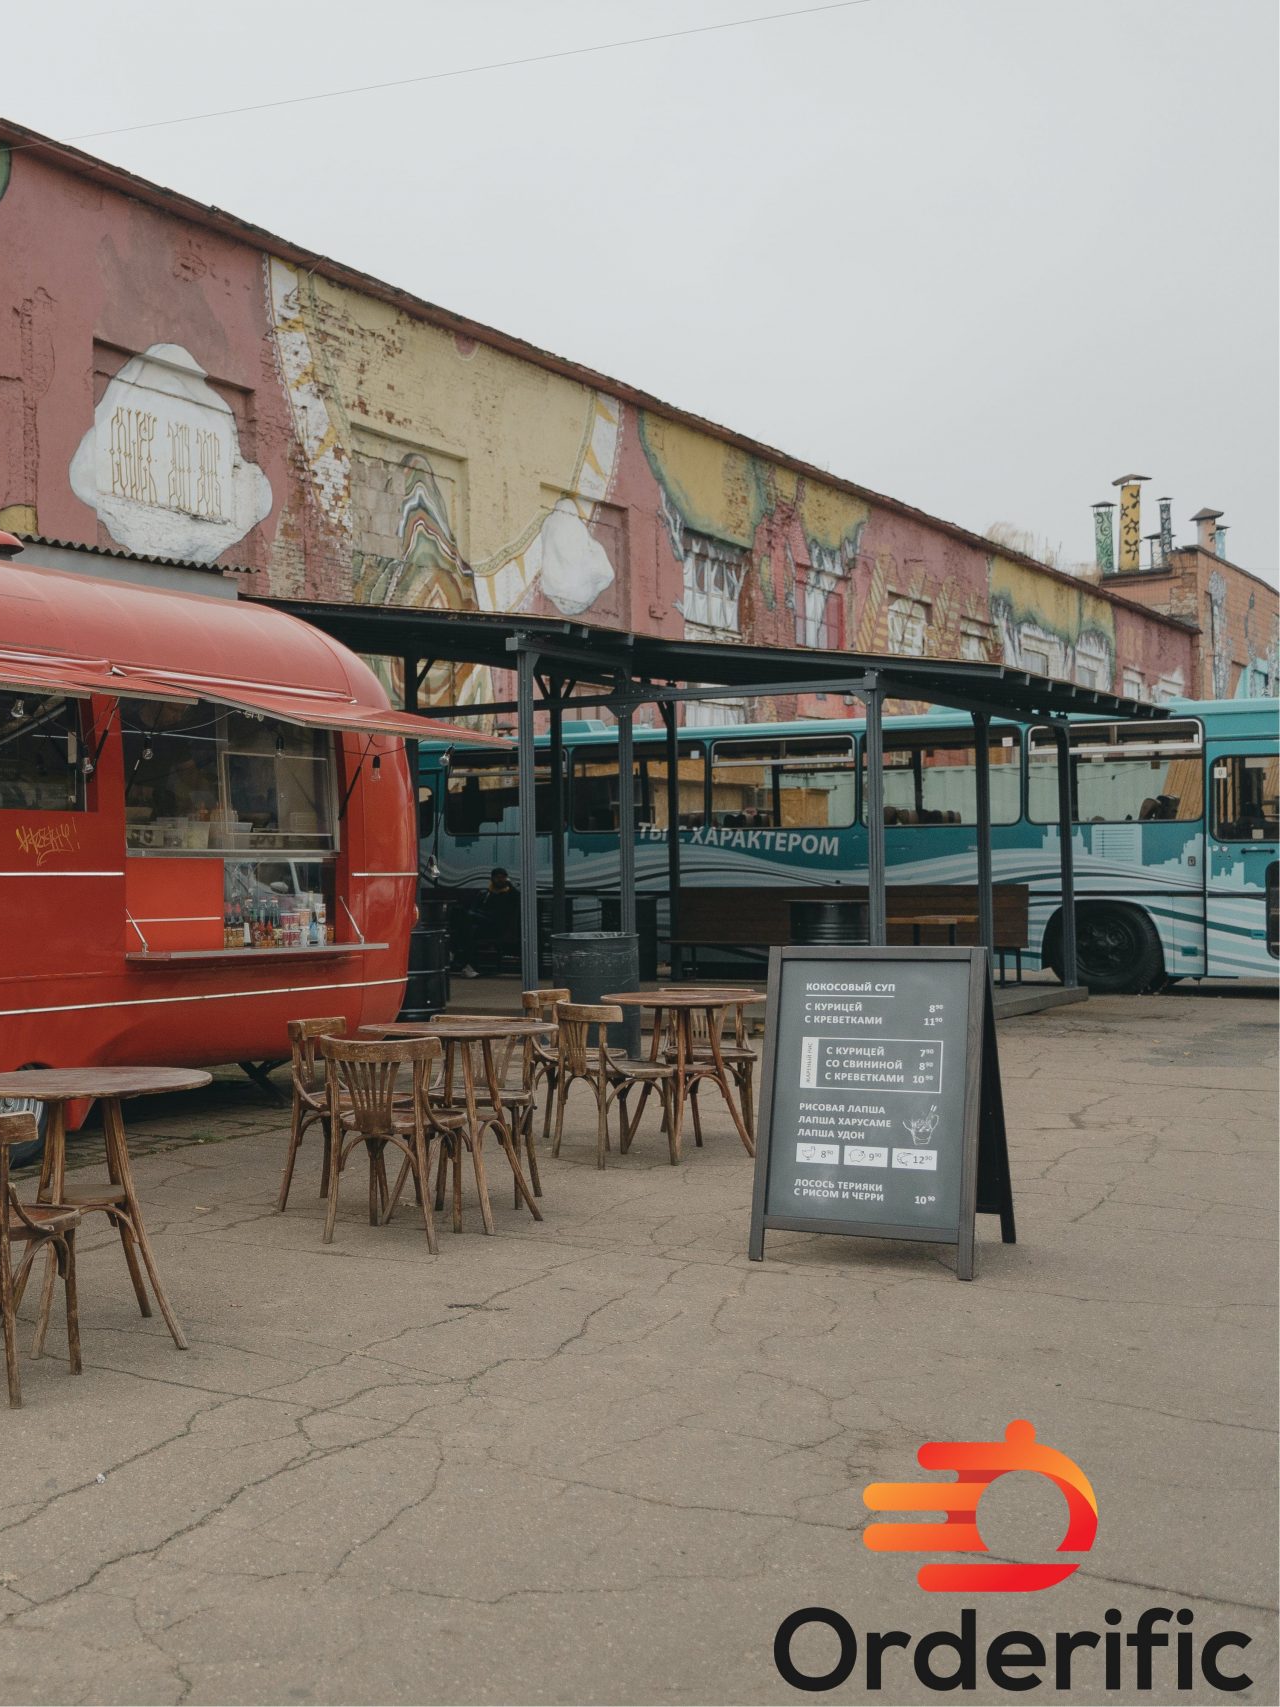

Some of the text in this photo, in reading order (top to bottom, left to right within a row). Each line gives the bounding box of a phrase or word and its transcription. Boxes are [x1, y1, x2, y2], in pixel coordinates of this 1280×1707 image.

[690, 826, 839, 856] ХАРАКТЕРОМ
[806, 982, 896, 992] КОКОСОВЫЙ СУП
[805, 1003, 812, 1011] С
[814, 1002, 863, 1013] КУРИЦЕЙ
[804, 1015, 811, 1023] С
[813, 1015, 883, 1025] КРЕВЕТКАМИ
[826, 1046, 833, 1055] С
[835, 1046, 885, 1057] КУРИЦЕЙ
[825, 1059, 840, 1068] СО
[842, 1059, 903, 1070] СВИНИНОЙ
[824, 1072, 831, 1080] С
[834, 1072, 905, 1083] КРЕВЕТКАМИ
[799, 1102, 886, 1114] РИСОВАЯ ЛАПША
[798, 1116, 892, 1128] ЛАПША ХАРУСАМЕ
[797, 1128, 865, 1140] ЛАПША УДОН
[794, 1178, 883, 1192] ЛОСОСЬ ТЕРИЯКИ
[793, 1188, 884, 1202] С РИСОМ И ЧЕРРИ
